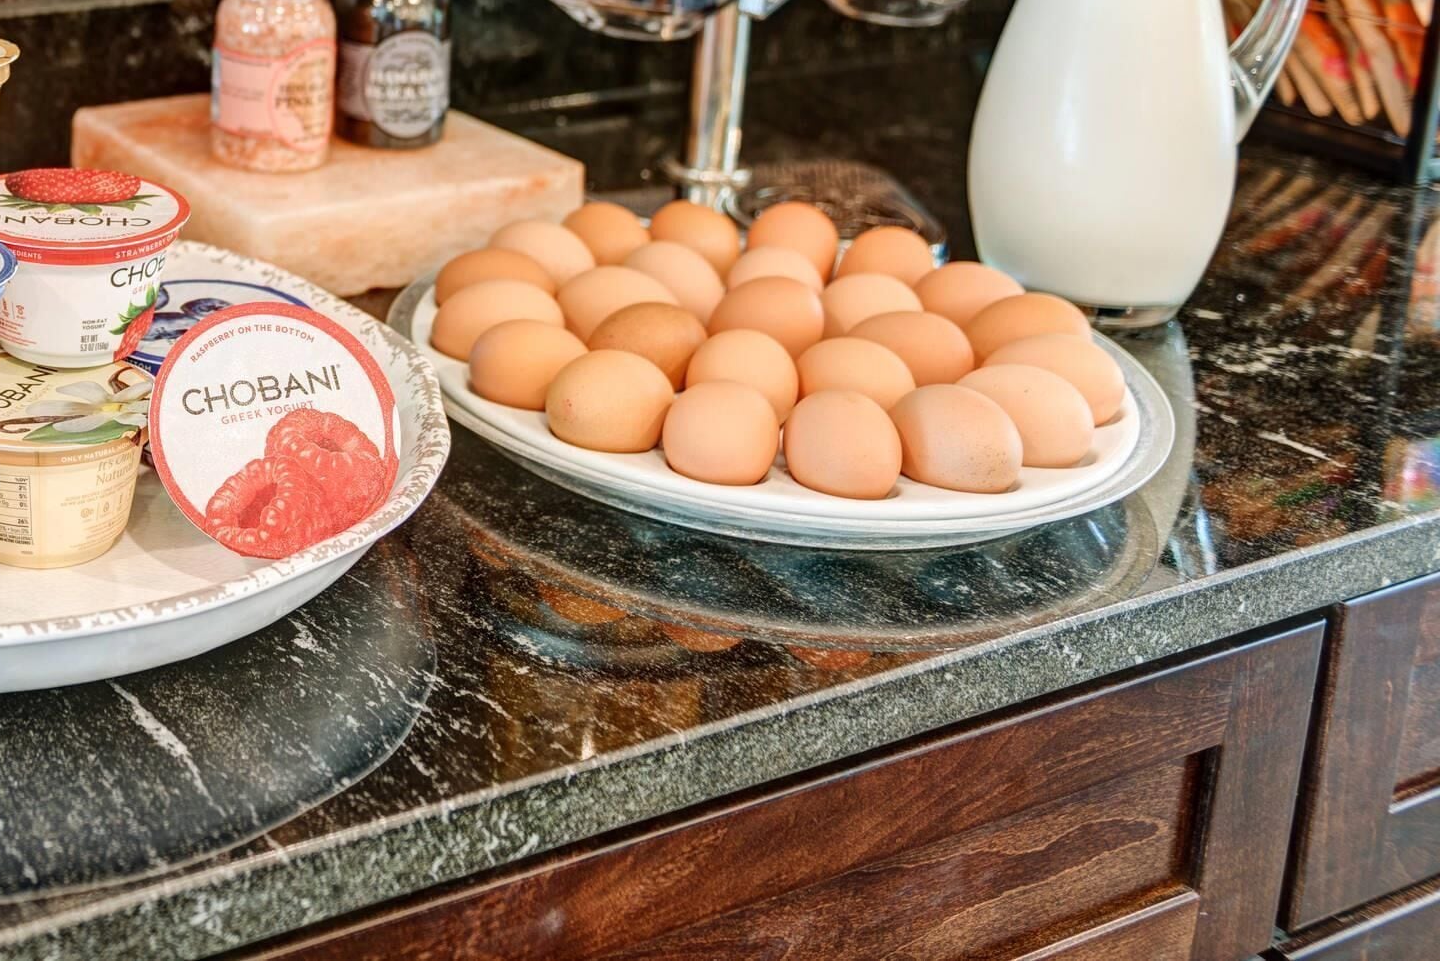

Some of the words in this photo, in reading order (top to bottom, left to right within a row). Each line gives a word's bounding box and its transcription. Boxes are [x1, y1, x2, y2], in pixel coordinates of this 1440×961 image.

[80, 335, 90, 343] NET
[190, 331, 235, 363] RASPBERRY
[238, 325, 252, 335] ON
[254, 324, 272, 333] THE
[275, 325, 315, 342] BOTTOM
[182, 364, 341, 416] CHOBANI
[221, 407, 262, 425] GREEK
[267, 401, 314, 416] YOGURT
[61, 455, 83, 463] ONLY
[84, 447, 116, 459] NATURAL
